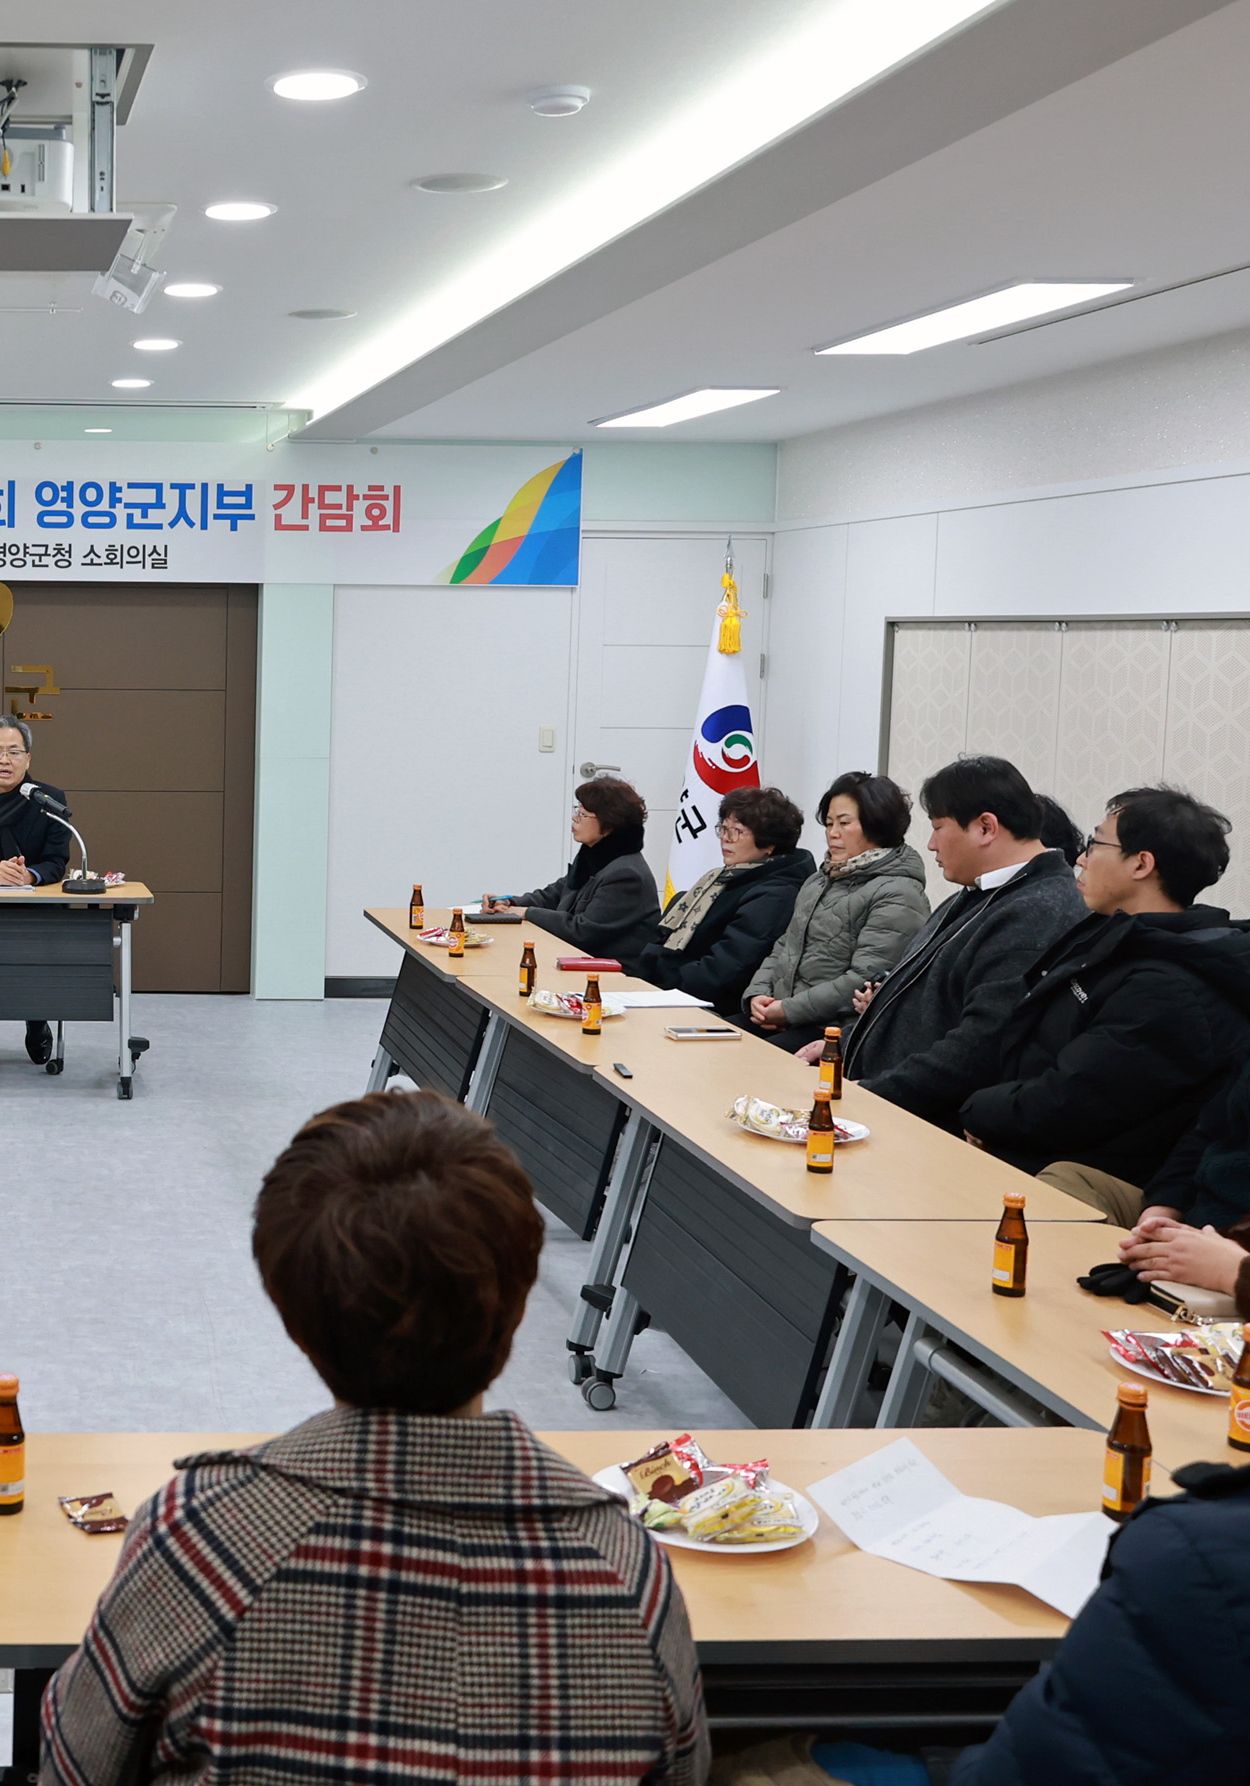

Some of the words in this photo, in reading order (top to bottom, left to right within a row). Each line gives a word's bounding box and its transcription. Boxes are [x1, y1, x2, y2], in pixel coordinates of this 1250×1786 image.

[35, 480, 256, 532] 영양군지부
[272, 483, 402, 533] 간담회
[81, 544, 168, 569] 소회의실
